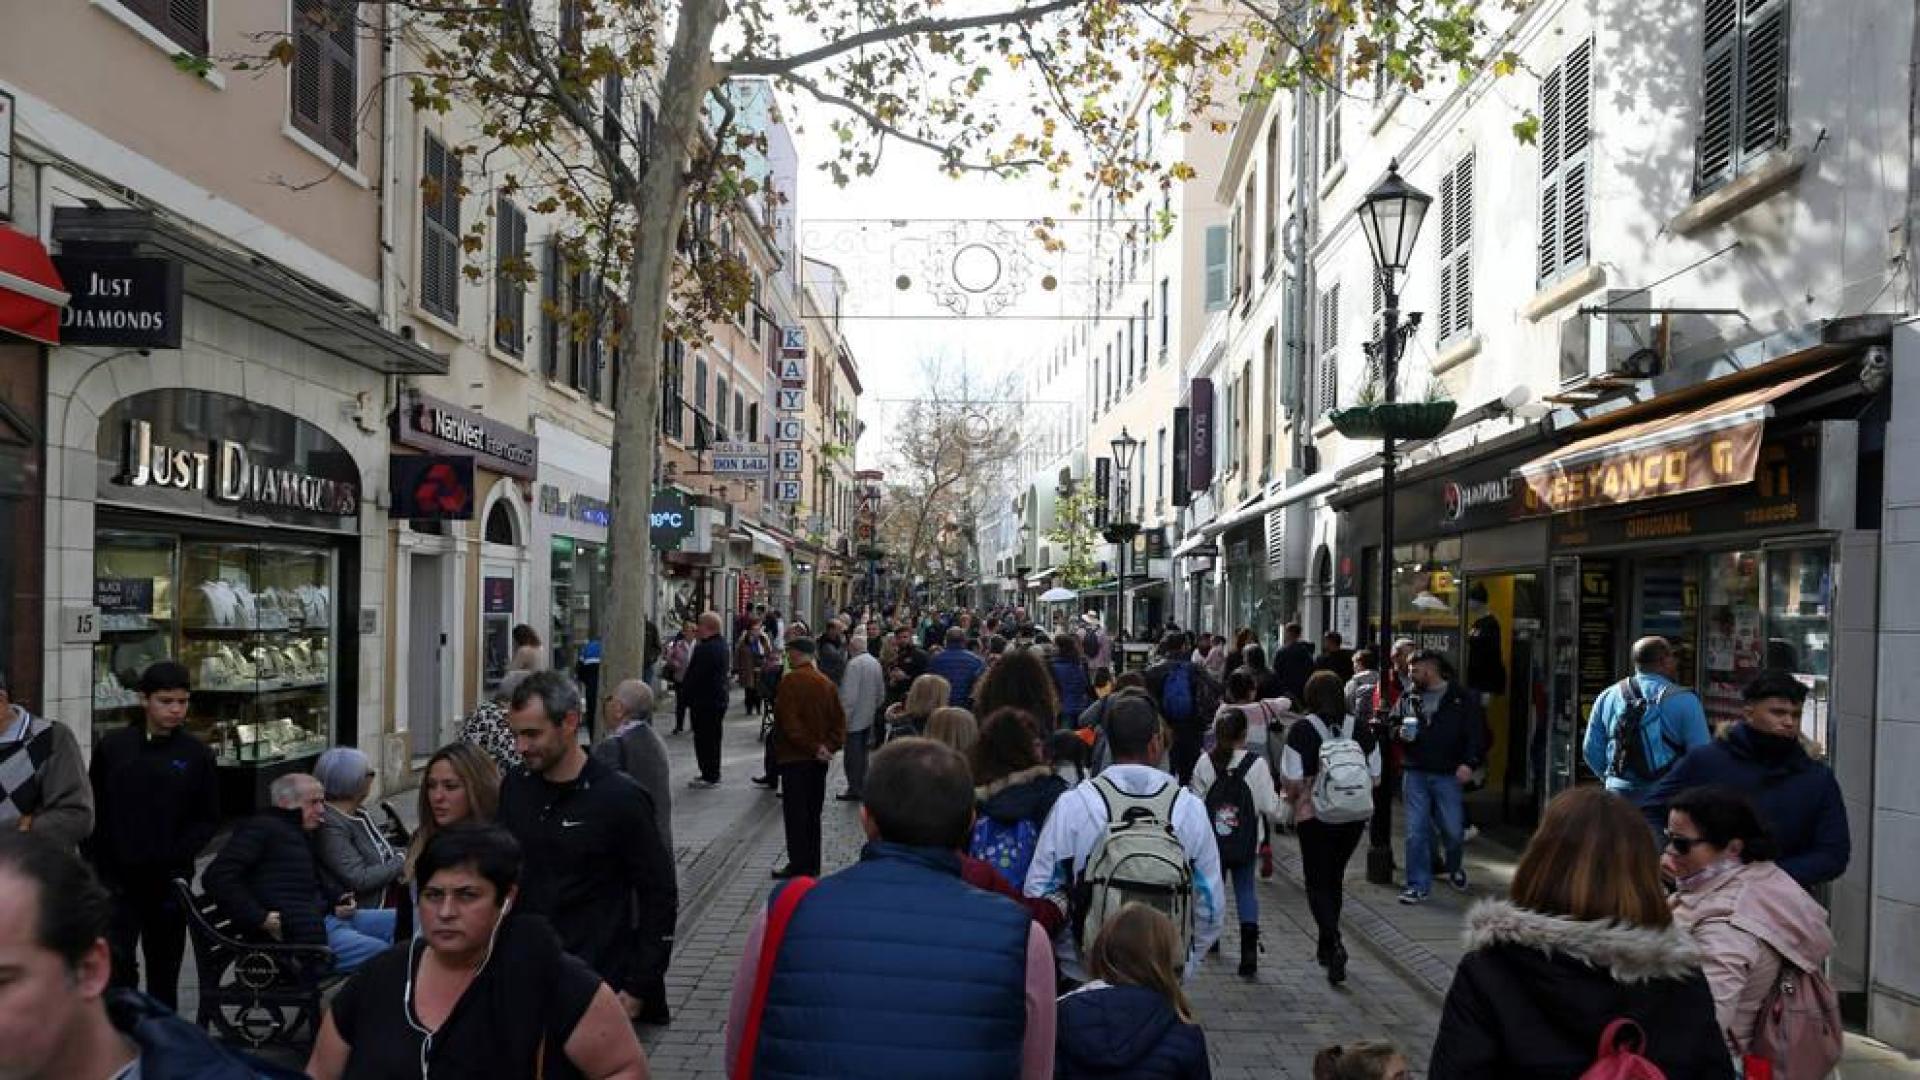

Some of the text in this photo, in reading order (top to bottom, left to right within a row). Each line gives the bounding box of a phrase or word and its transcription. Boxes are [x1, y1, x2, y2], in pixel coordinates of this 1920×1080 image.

[89, 271, 133, 296] JUST
[61, 305, 163, 330] DIAMONDS
[434, 408, 485, 453] NatWest
[783, 329, 801, 499] KAYCEE
[130, 419, 209, 490] JUST
[77, 614, 93, 633] 15
